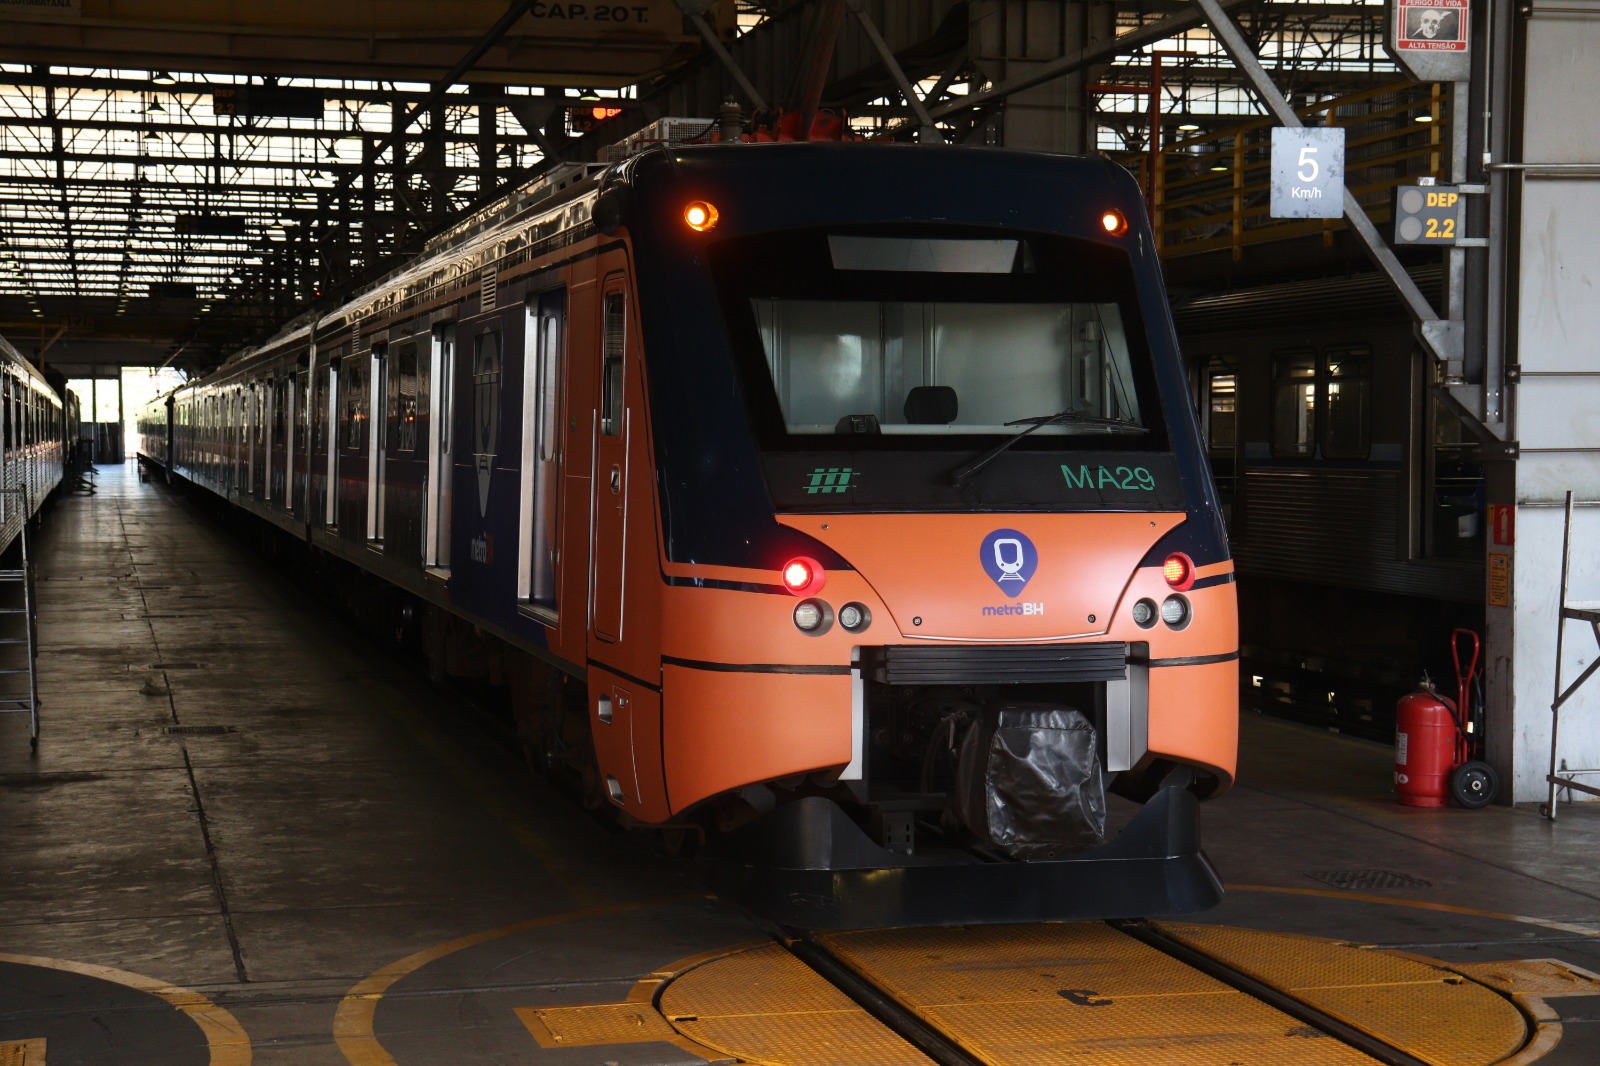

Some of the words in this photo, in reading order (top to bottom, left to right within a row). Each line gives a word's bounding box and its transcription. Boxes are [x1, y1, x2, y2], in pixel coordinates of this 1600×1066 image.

[530, 2, 588, 20] CAP.
[1427, 41, 1456, 50] TENSÃO
[214, 88, 236, 97] DEP
[1297, 147, 1319, 182] 5
[1291, 186, 1322, 199] Km/h
[1427, 192, 1457, 207] DEP
[1425, 218, 1455, 238] 2.2
[1060, 464, 1155, 491] MA29
[982, 602, 1044, 616] metrôBH
